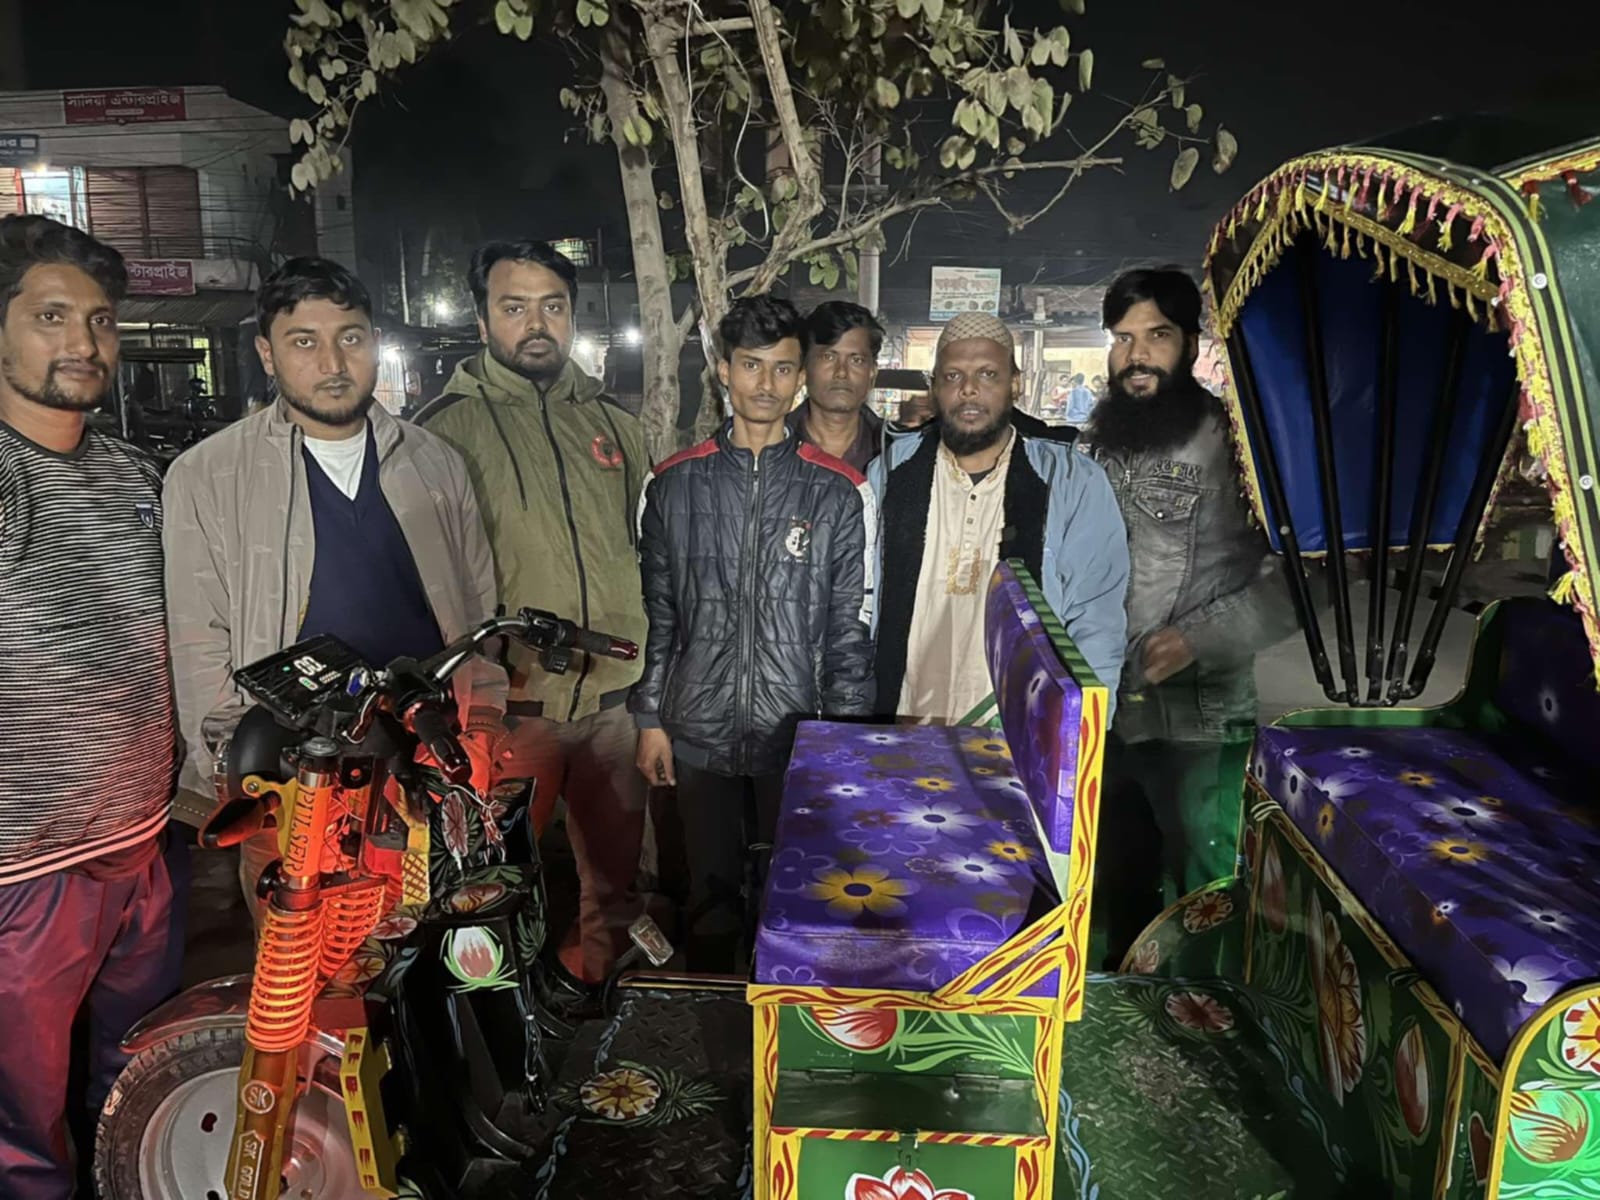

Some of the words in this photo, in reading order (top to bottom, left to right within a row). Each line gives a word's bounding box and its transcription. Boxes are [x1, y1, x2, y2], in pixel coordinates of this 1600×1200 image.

[127, 262, 190, 279] ন্টারপ্রাইজ
[285, 786, 316, 872] PULSER
[248, 1086, 268, 1109] SK
[243, 1140, 257, 1160] SK
[239, 1165, 254, 1199] GOLD
